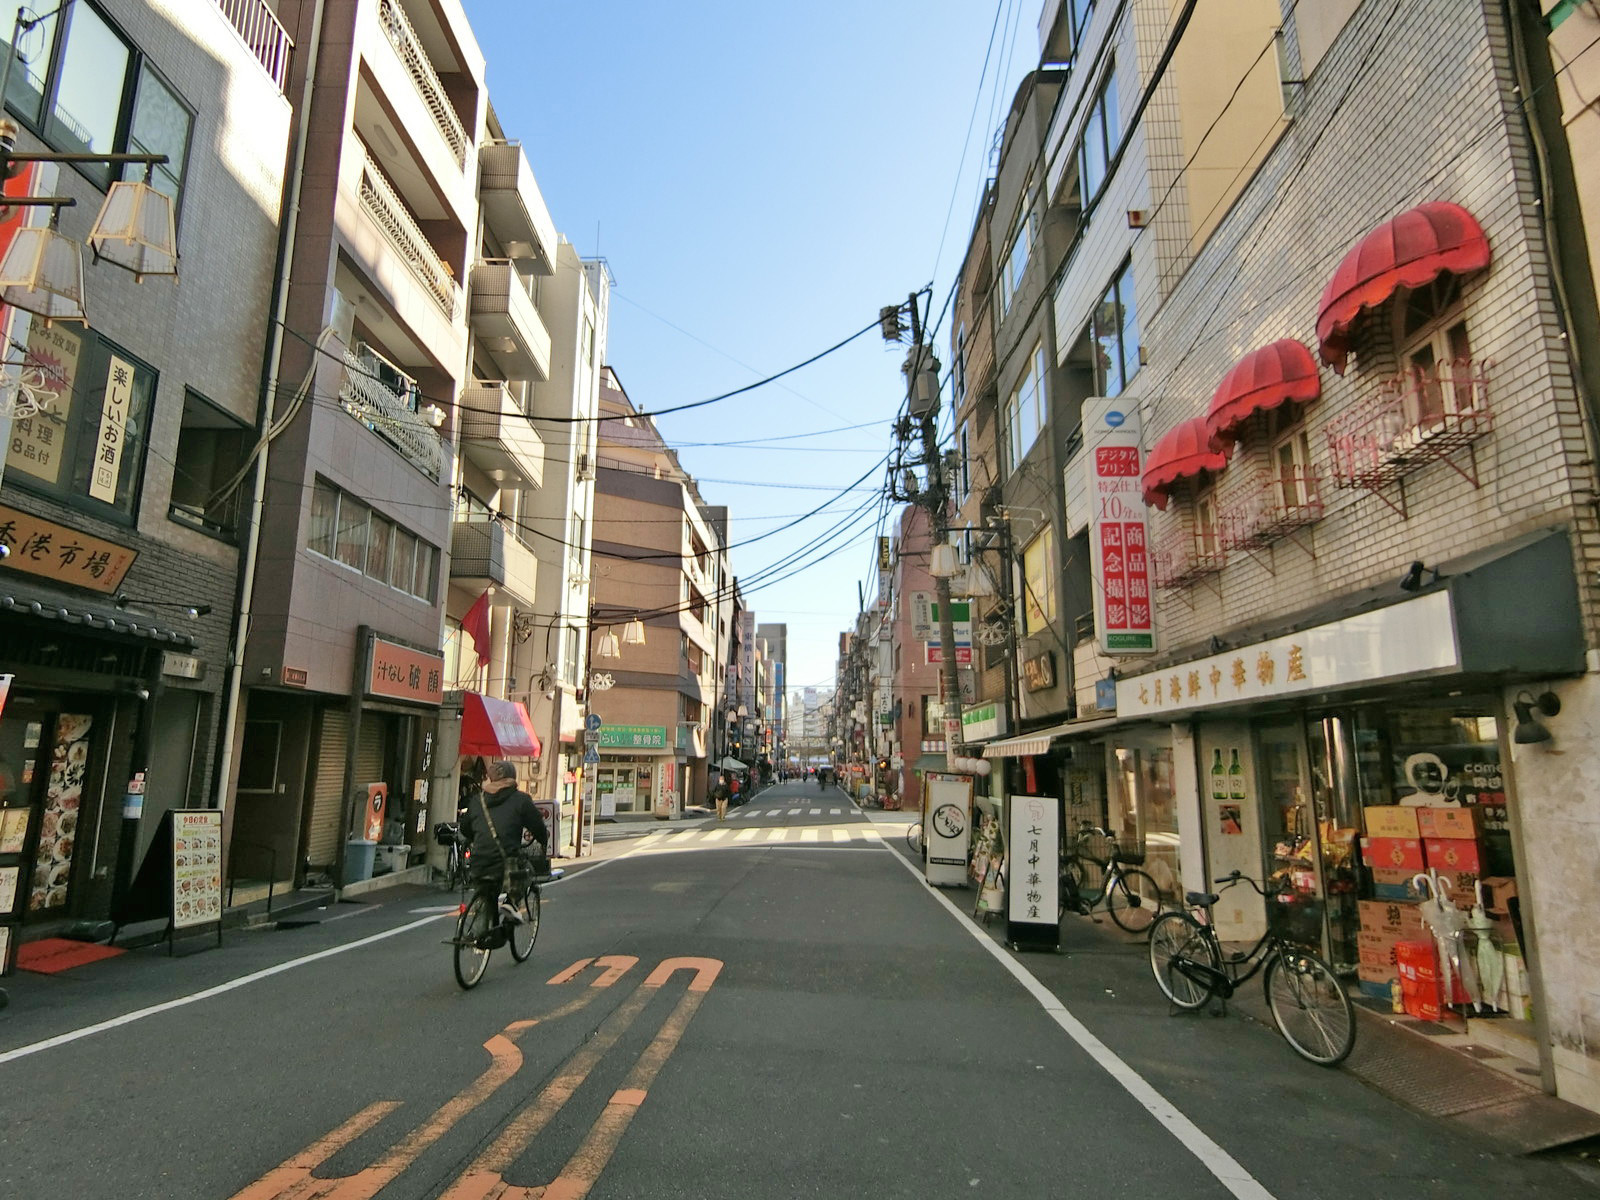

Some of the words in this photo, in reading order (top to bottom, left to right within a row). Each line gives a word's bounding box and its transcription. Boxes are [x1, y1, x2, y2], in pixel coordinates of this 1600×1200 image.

[16, 418, 54, 446] 料理
[100, 365, 128, 465] 楽しいお酒
[12, 438, 50, 465] 8品付
[1098, 450, 1138, 461] デジタル
[1099, 464, 1138, 475] プリント
[1104, 527, 1125, 625] 記念撮影
[1127, 526, 1149, 625] 商品撮影
[633, 734, 662, 745] 整骨院
[1026, 825, 1043, 919] 七月中華物産
[228, 955, 724, 1200] 30
